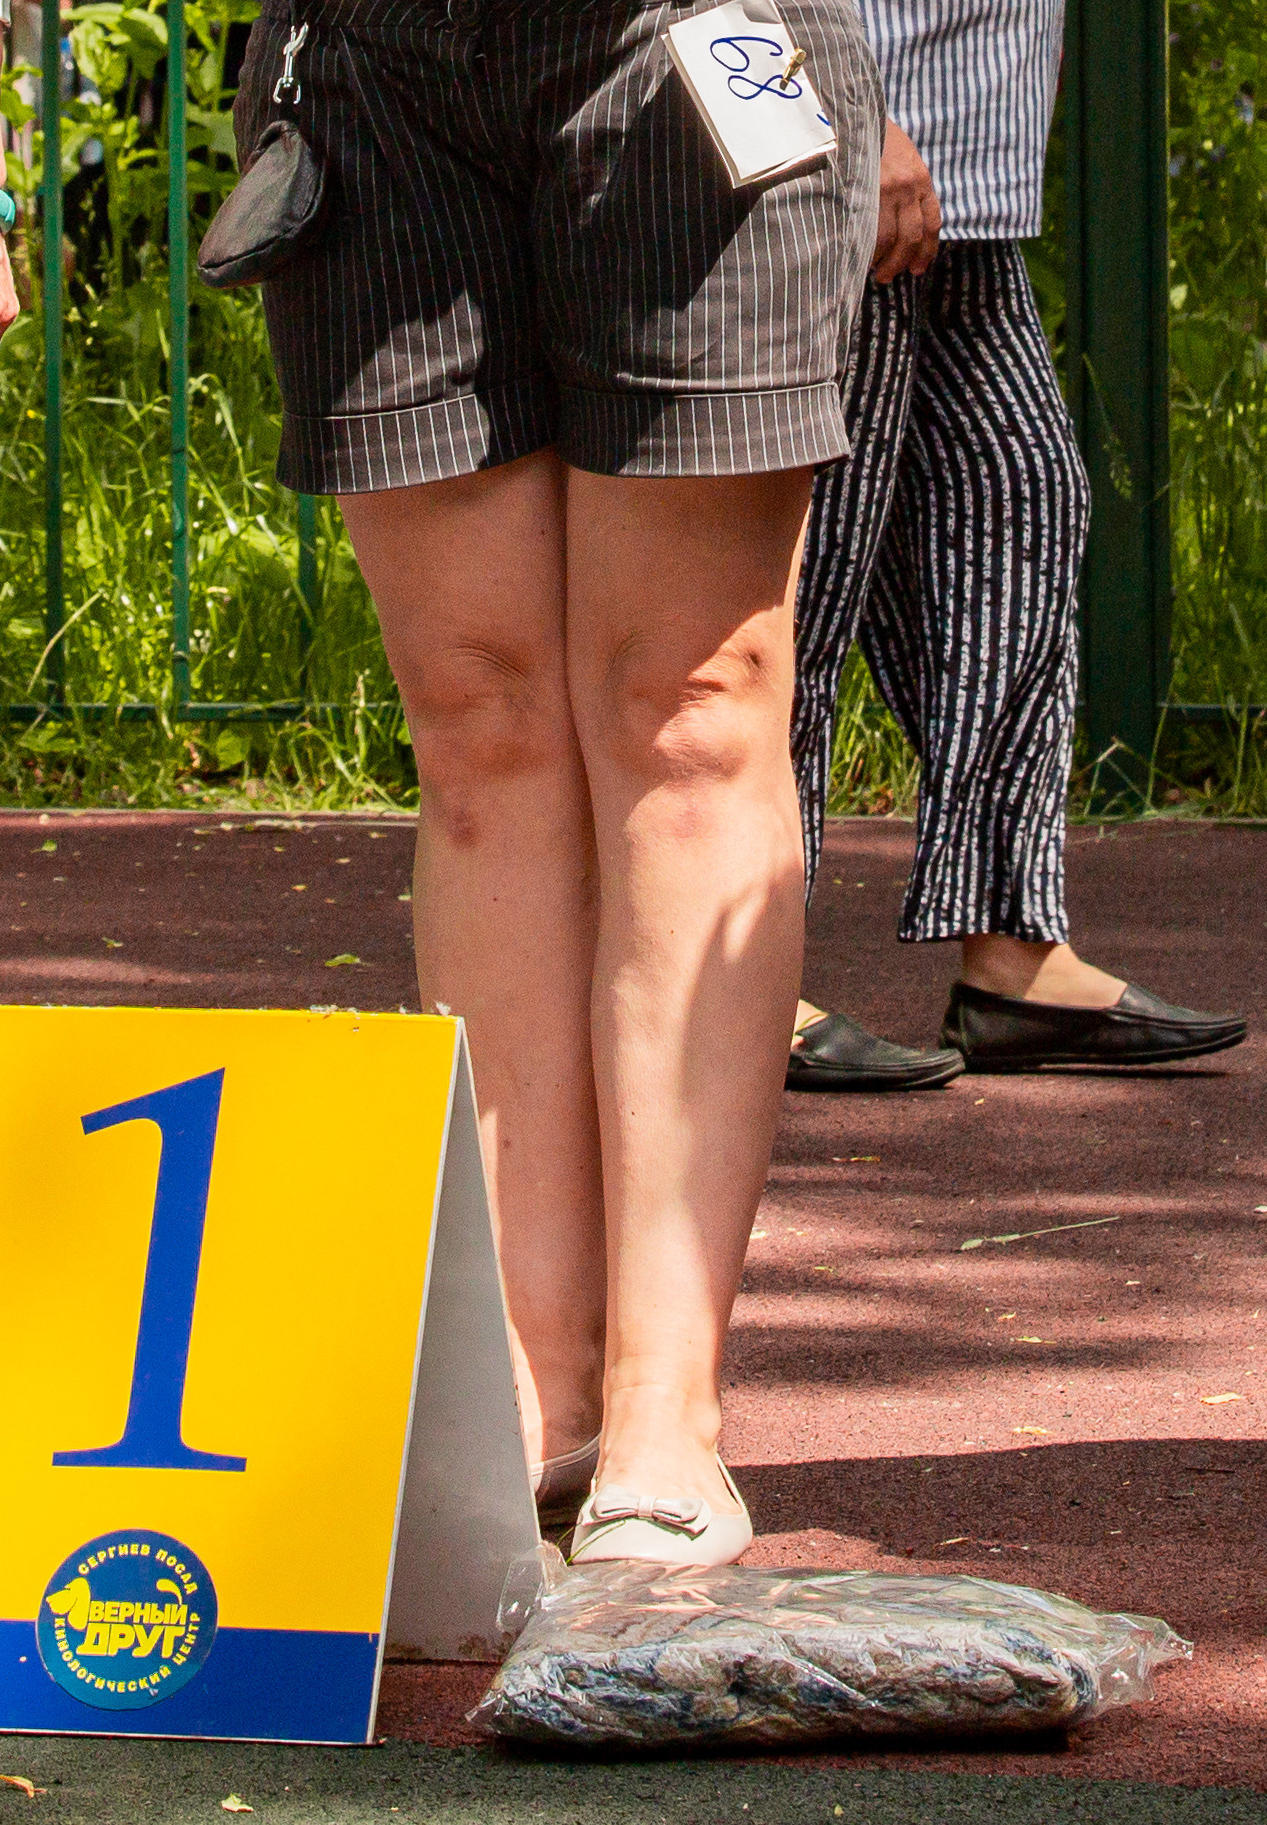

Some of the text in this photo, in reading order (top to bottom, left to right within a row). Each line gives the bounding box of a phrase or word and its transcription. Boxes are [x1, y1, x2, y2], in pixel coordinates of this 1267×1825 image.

[52, 1067, 247, 1473] 1
[78, 1543, 198, 1595] СЕРГИЕВ ПОСАД
[89, 1600, 189, 1625] ВЕРНЫЙ
[54, 1612, 201, 1694] КИНОЛОГИЧЕСКИЙ ЦЕНТР
[76, 1622, 186, 1659] ДРУГ
